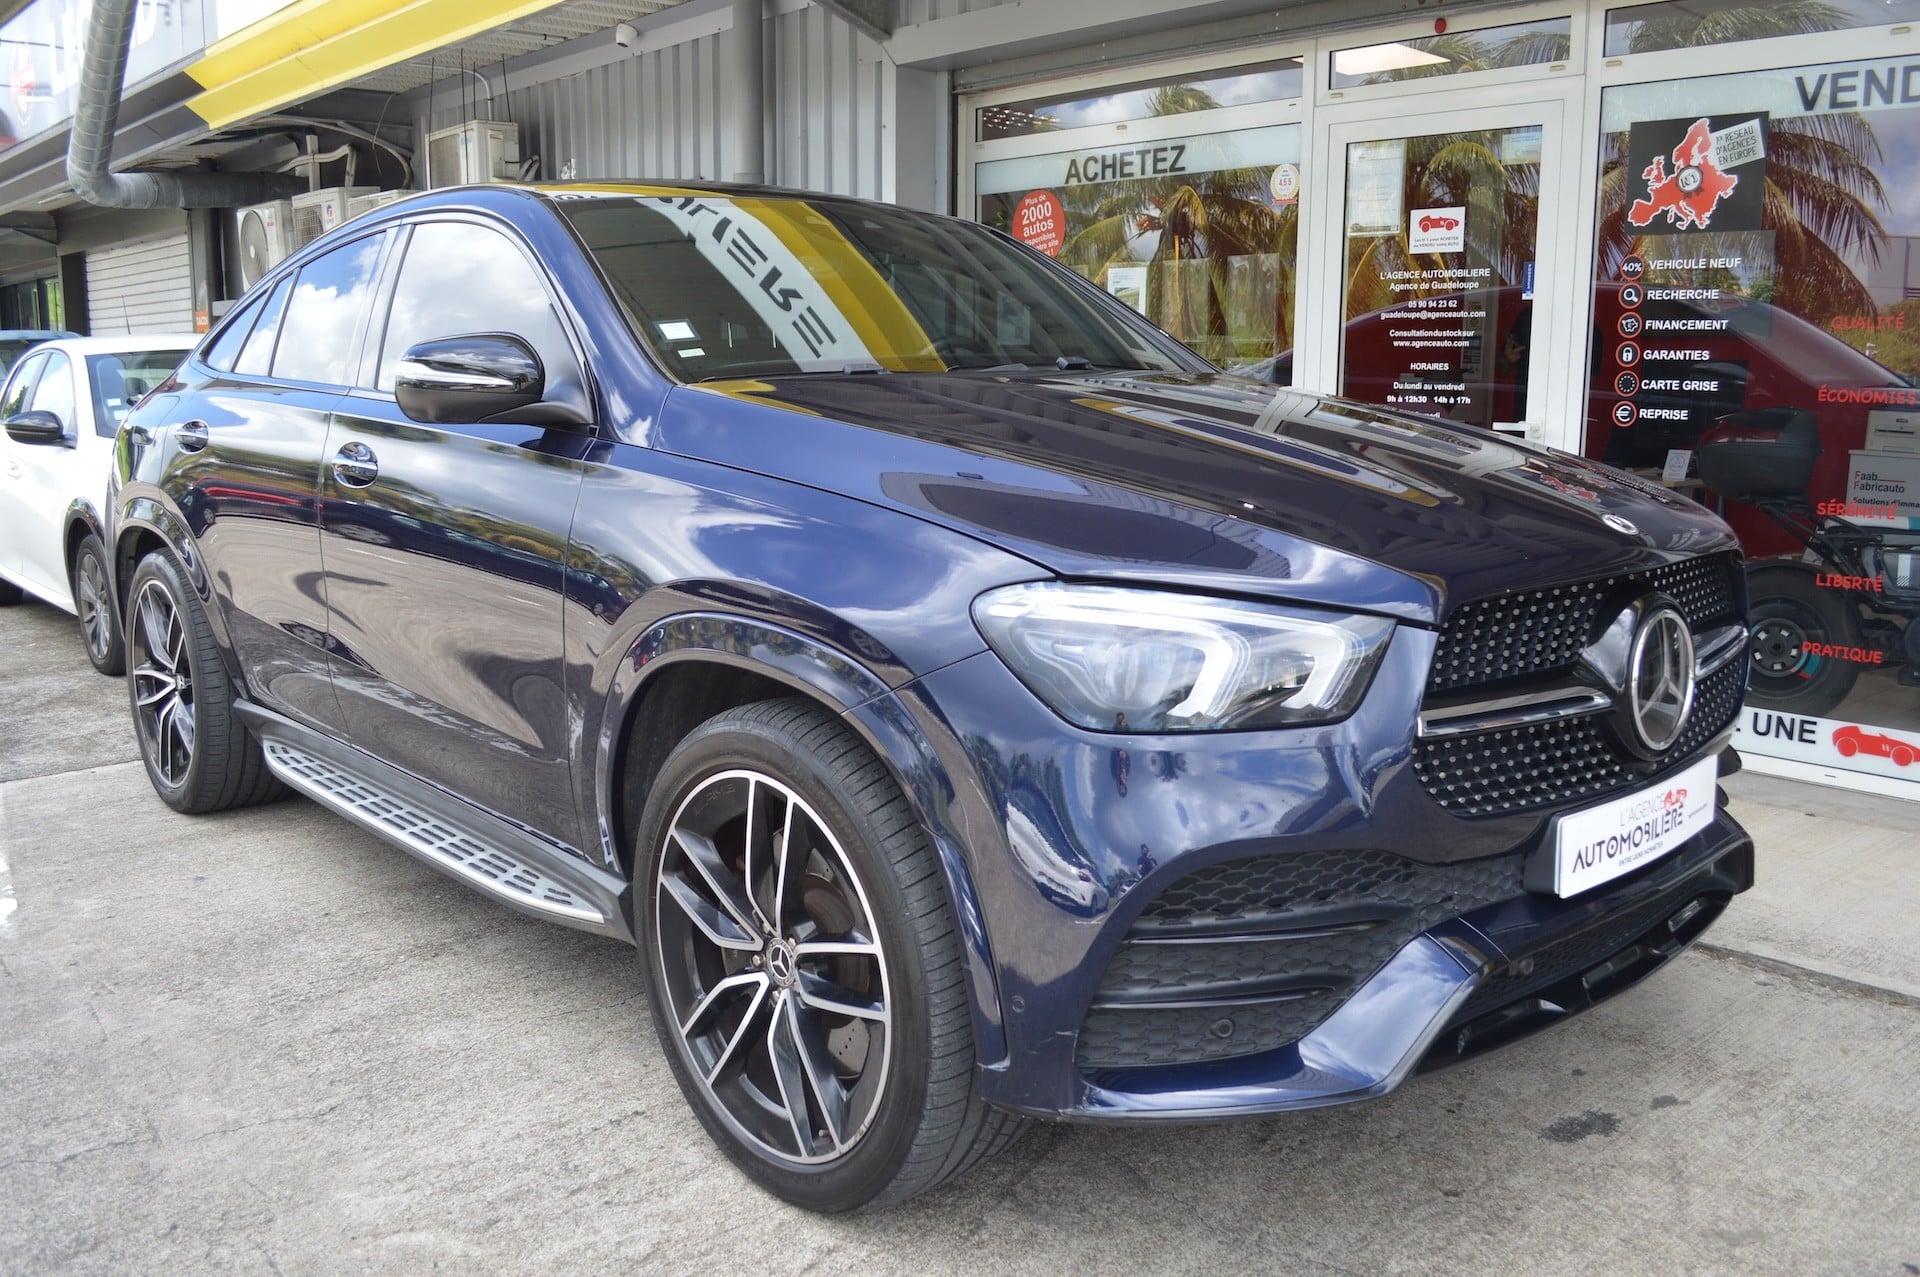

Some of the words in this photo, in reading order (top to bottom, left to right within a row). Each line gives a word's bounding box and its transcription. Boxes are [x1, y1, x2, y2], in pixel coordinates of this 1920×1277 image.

[1718, 155, 1728, 165] EN
[1729, 147, 1758, 161] EUROPE
[1064, 145, 1186, 185] ACHETEZ
[1024, 198, 1038, 206] Plus
[1021, 201, 1052, 225] 2000
[1023, 219, 1054, 237] autos
[1622, 263, 1642, 272] 40%
[1649, 258, 1707, 270] VEHICULE
[1709, 257, 1742, 268] NEUF
[1380, 270, 1420, 280] L'AGENCE
[1421, 268, 1491, 279] AUTOMOBILIERE
[1389, 282, 1418, 292] Agence
[1419, 282, 1430, 290] de
[1431, 280, 1479, 290] Guadeloupe
[1647, 289, 1719, 300] RECHERCHE
[1408, 300, 1417, 308] 05
[1418, 300, 1427, 308] 90
[1428, 300, 1437, 308] 94
[1438, 300, 1448, 308] 23
[1448, 300, 1458, 308] 62
[1380, 310, 1486, 320] guadeloupe@agenceauto.com
[1645, 320, 1728, 330] FINANCEMENT
[1831, 312, 1905, 331] QUALITÉ
[1393, 340, 1470, 348] www.agenceauto.com
[1643, 350, 1710, 360] GARANTIES
[1410, 362, 1449, 371] HORAIRES
[1393, 381, 1403, 390] Du
[1404, 382, 1423, 390] lundi
[1433, 382, 1465, 391] vendredi
[1641, 379, 1680, 390] CARTE
[1682, 380, 1719, 391] GRISE
[1386, 395, 1396, 403] 9h
[1397, 395, 1403, 403] à
[1404, 395, 1428, 403] 12h30
[1433, 395, 1448, 404] 14h
[1449, 396, 1455, 404] à
[1456, 396, 1471, 404] 17h
[1818, 384, 1917, 405] ÉCONOMIES
[1639, 408, 1689, 420] REPRISE
[1855, 471, 1878, 481] Faab
[1854, 481, 1905, 493] Fabricauto
[1853, 497, 1889, 506] Solutions
[1817, 499, 1897, 519] SÉRÉNITÉ
[1816, 573, 1883, 592] LIBERTÉ
[1802, 641, 1883, 664] PRATIQUE
[1752, 712, 1817, 744] UNE
[1620, 793, 1665, 826] L'AGENCE
